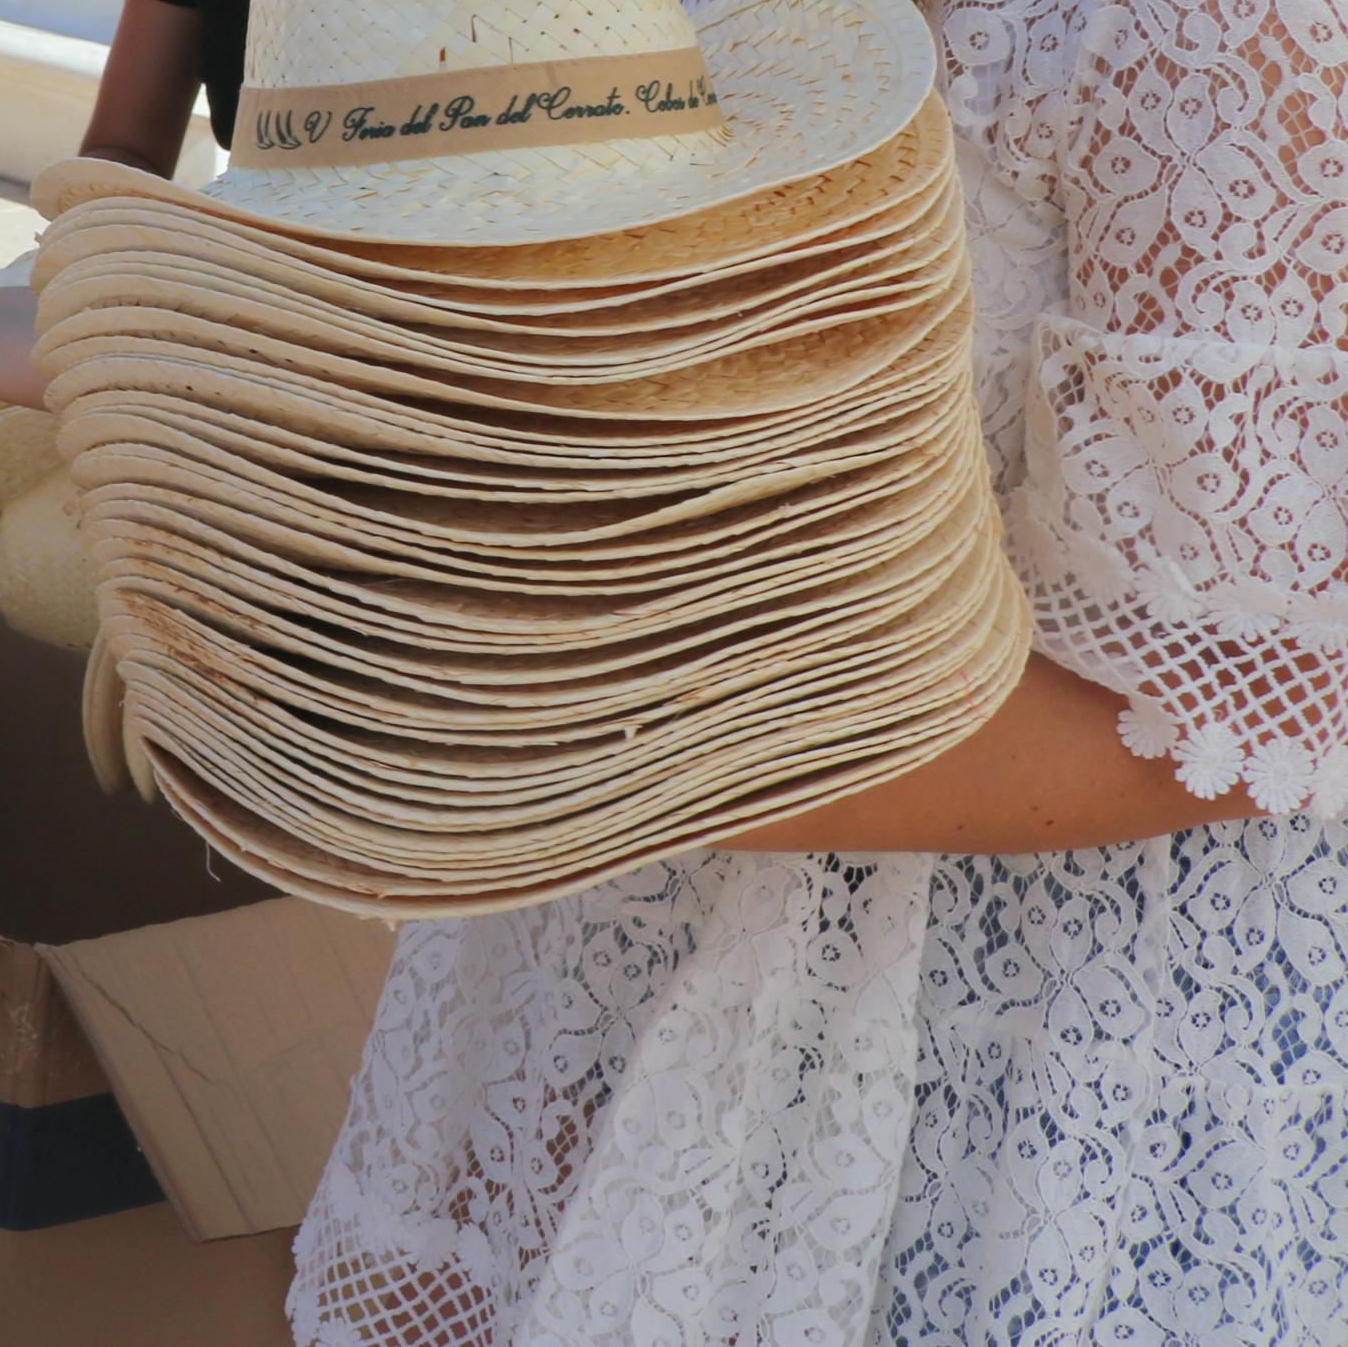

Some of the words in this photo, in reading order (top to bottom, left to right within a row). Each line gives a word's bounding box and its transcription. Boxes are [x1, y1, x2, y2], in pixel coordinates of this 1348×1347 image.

[342, 106, 396, 142] Feria
[400, 102, 439, 137] del
[438, 95, 492, 132] Pan
[496, 93, 536, 126] del
